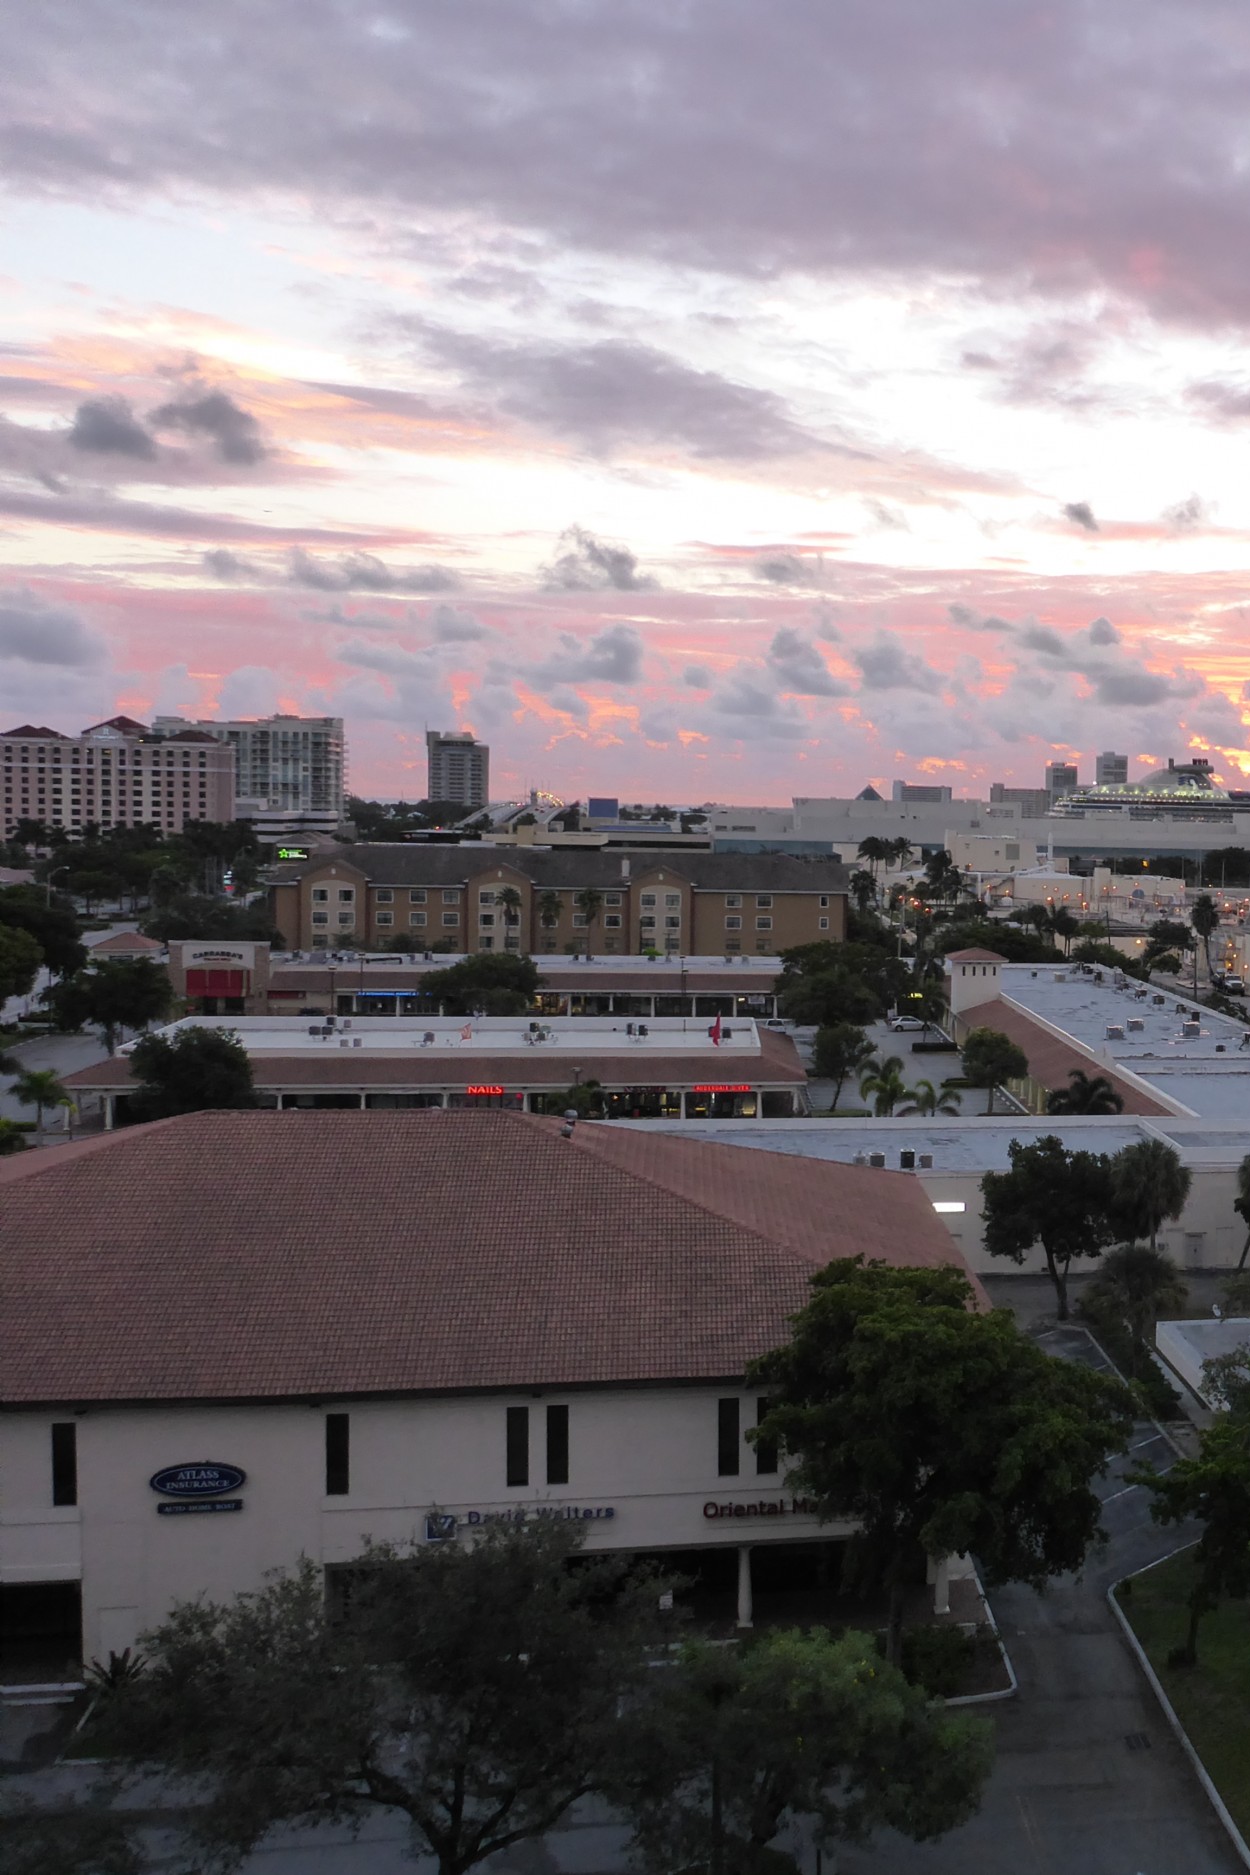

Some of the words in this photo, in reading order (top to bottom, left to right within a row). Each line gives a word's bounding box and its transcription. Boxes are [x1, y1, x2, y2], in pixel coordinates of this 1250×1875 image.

[467, 1085, 503, 1094] NAILS
[177, 1470, 220, 1480] ATLASS
[166, 1480, 230, 1489] INSURANCE
[702, 1499, 784, 1519] Oriental
